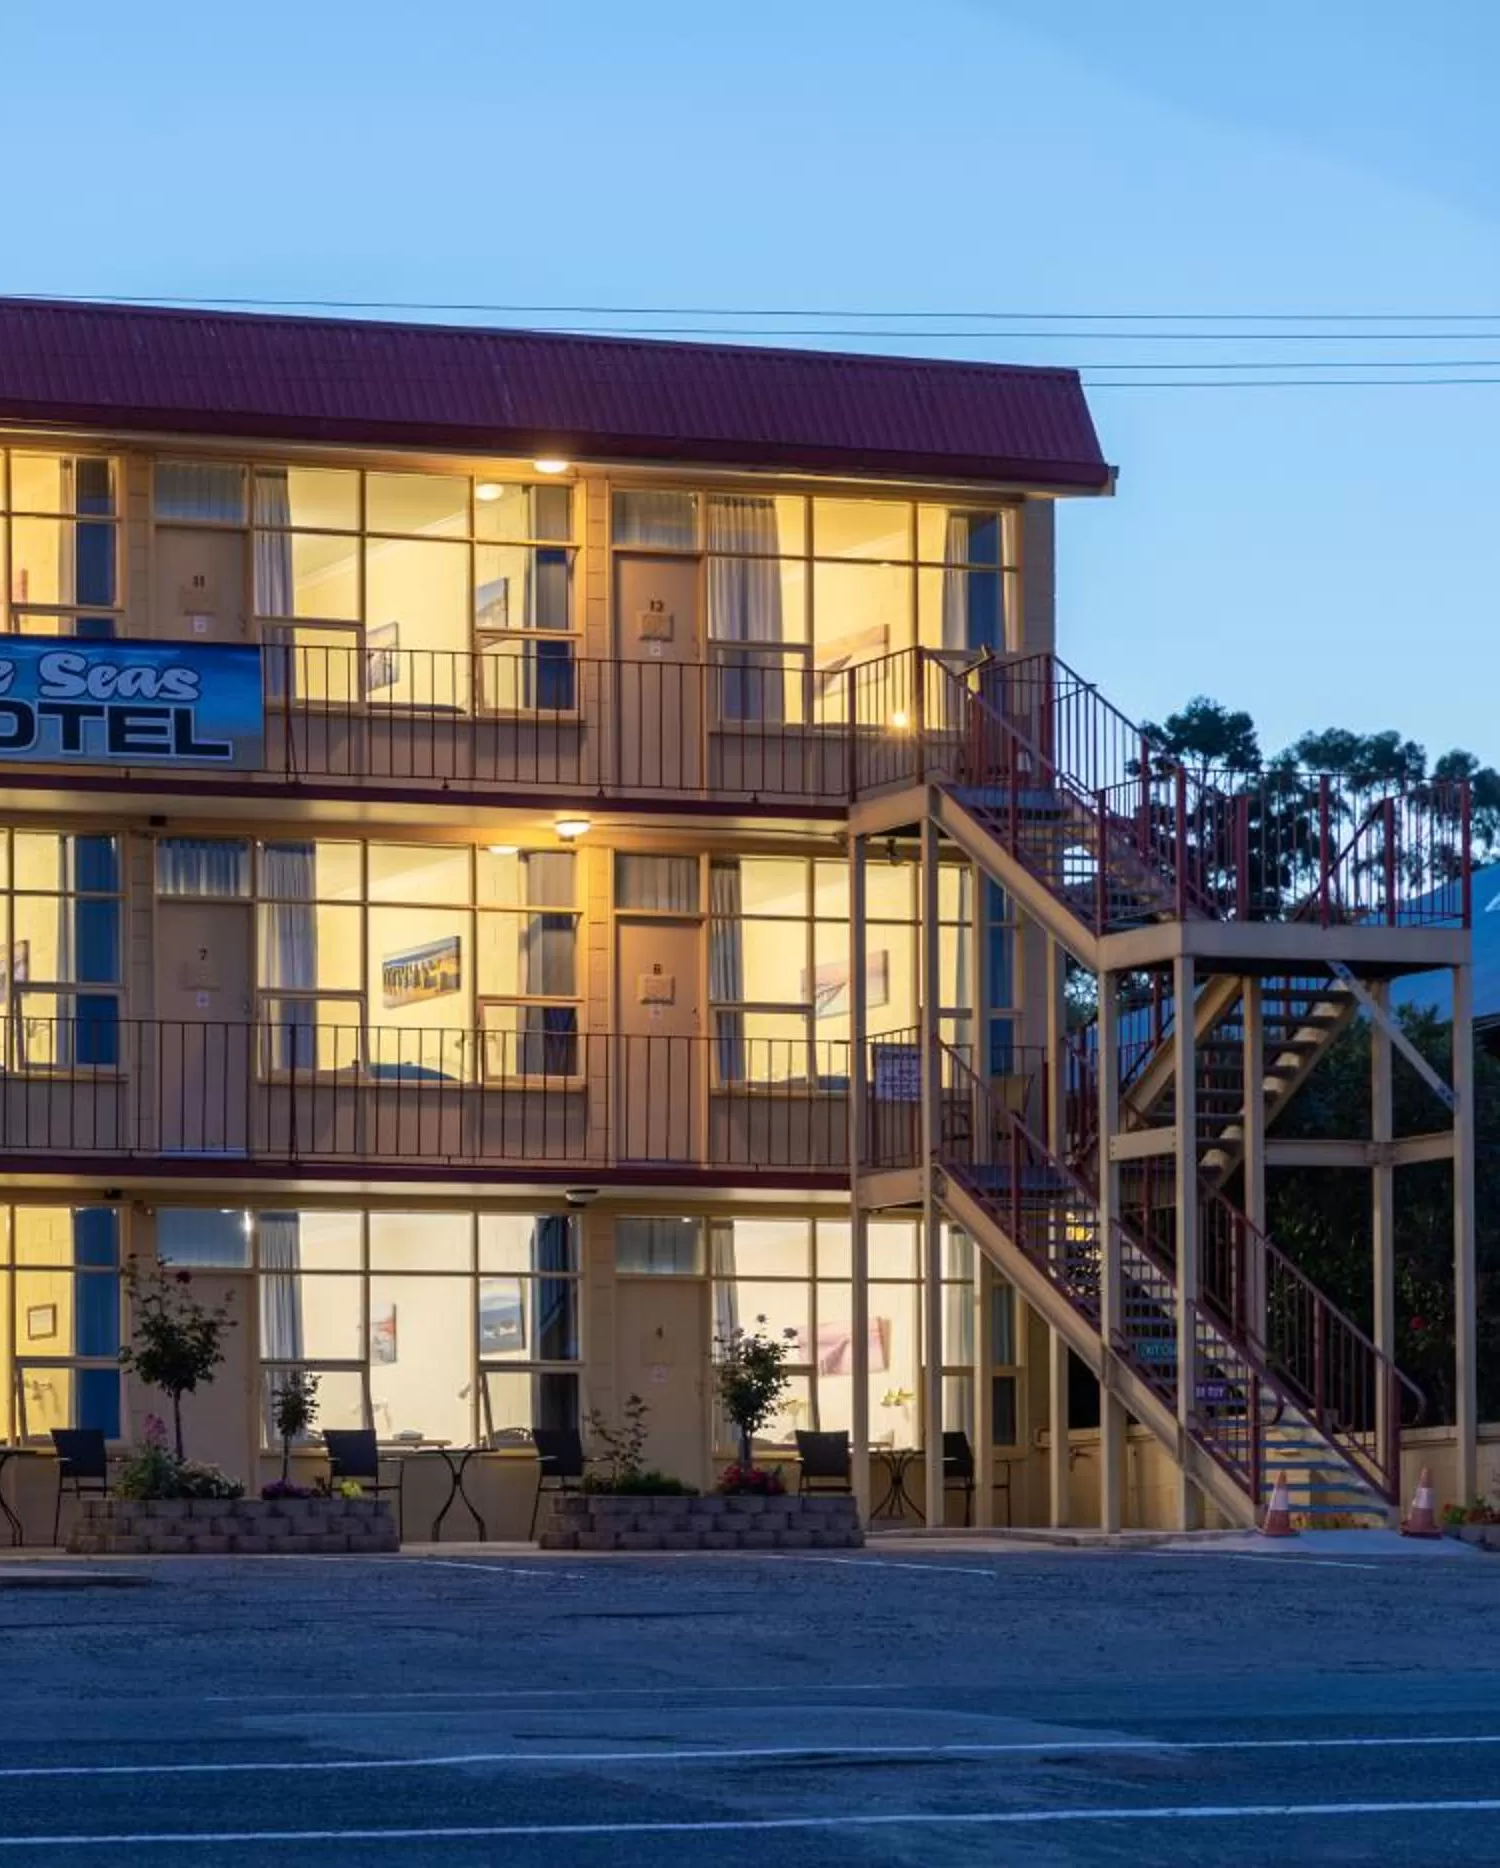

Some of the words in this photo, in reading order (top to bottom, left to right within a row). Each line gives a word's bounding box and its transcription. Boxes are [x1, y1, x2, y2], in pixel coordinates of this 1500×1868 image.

[193, 575, 206, 588] 11
[650, 599, 665, 612] 12
[38, 650, 202, 702] Seas
[199, 949, 208, 960] 7
